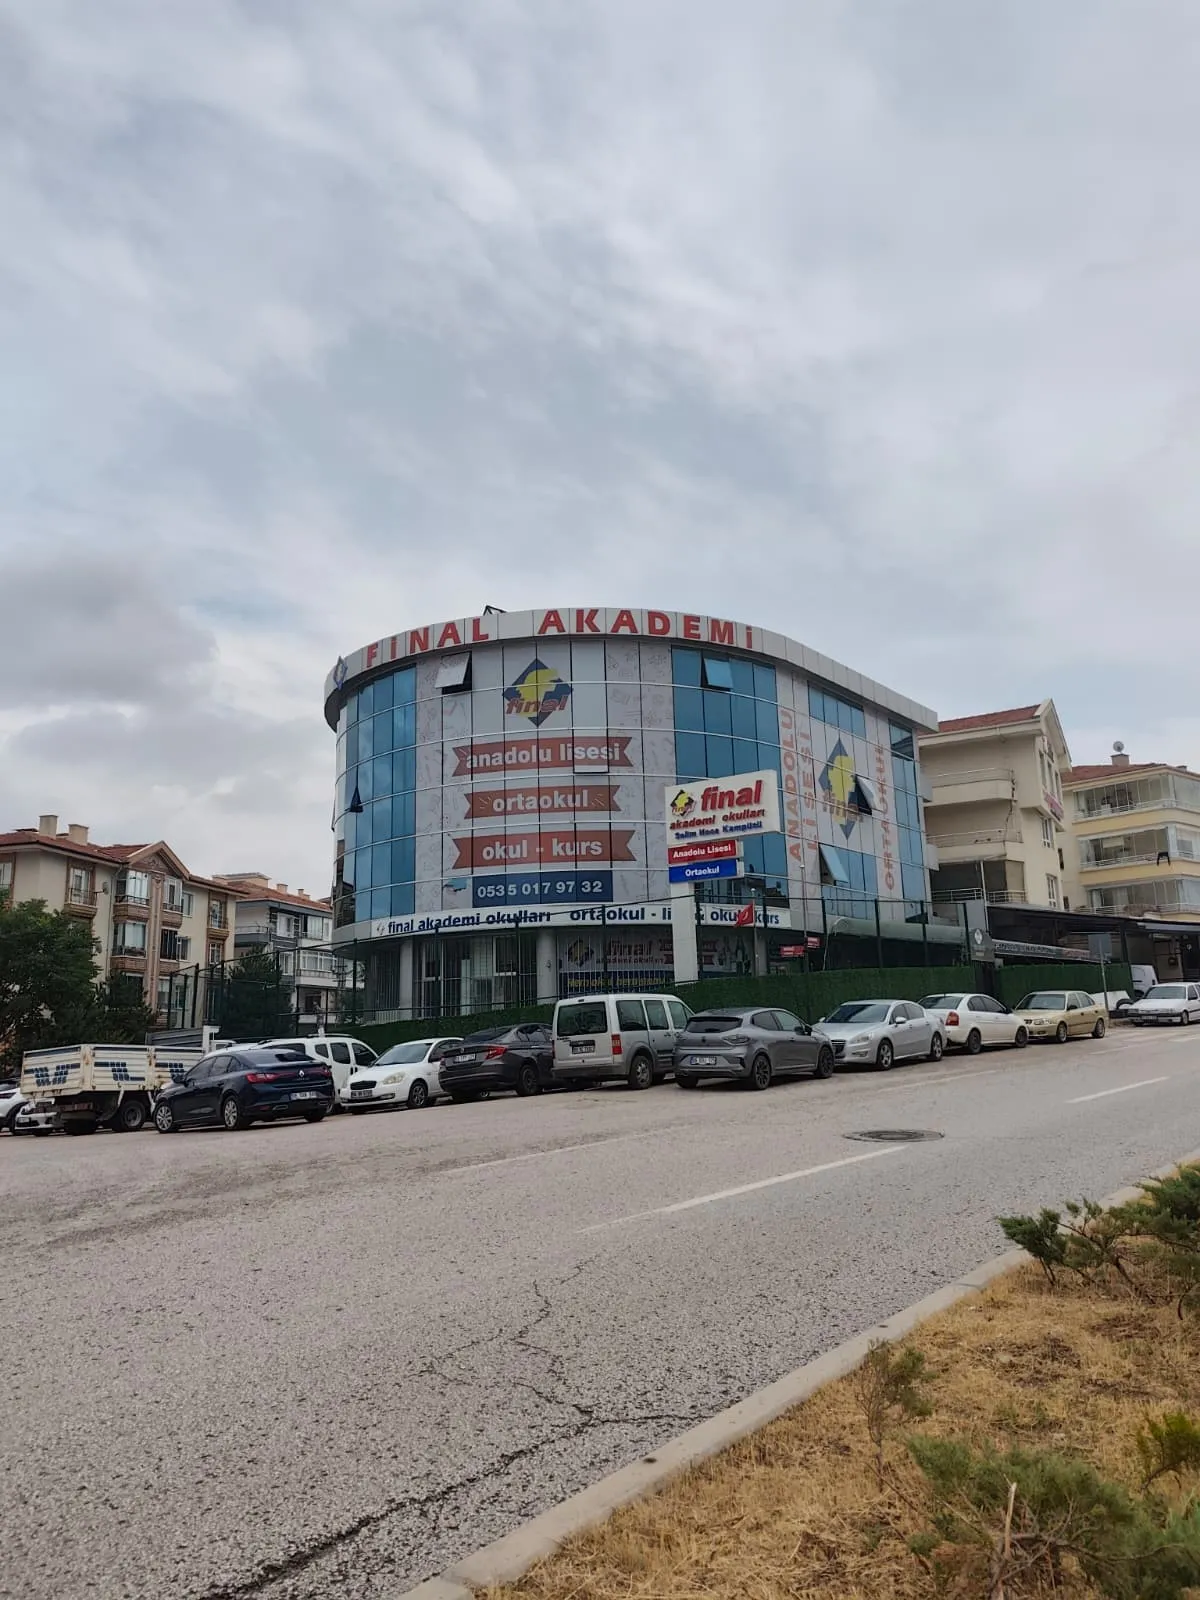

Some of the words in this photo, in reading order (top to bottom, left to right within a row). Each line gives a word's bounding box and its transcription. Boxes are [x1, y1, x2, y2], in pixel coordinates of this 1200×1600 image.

[366, 617, 489, 668] FİNAL
[537, 609, 753, 649] AKADEMİ
[466, 745, 552, 769] anadolu
[560, 743, 620, 760] lisesi
[701, 780, 762, 811] final
[781, 710, 802, 862] ANADOLU
[800, 732, 819, 851] LİSESİ
[493, 790, 588, 812] ortaokul
[670, 815, 716, 829] akademi
[722, 809, 765, 821] okulları
[482, 840, 528, 860] okul
[552, 838, 602, 856] kurs
[673, 848, 705, 858] Anadolu
[707, 844, 731, 853] Lisesi
[685, 866, 720, 877] Ortaokul
[522, 882, 550, 895] 017
[556, 881, 575, 894] 97
[581, 880, 602, 893] 32
[388, 920, 413, 934] final
[418, 913, 480, 931] akademi
[486, 909, 550, 925] okulları
[570, 907, 645, 921] ortaokul
